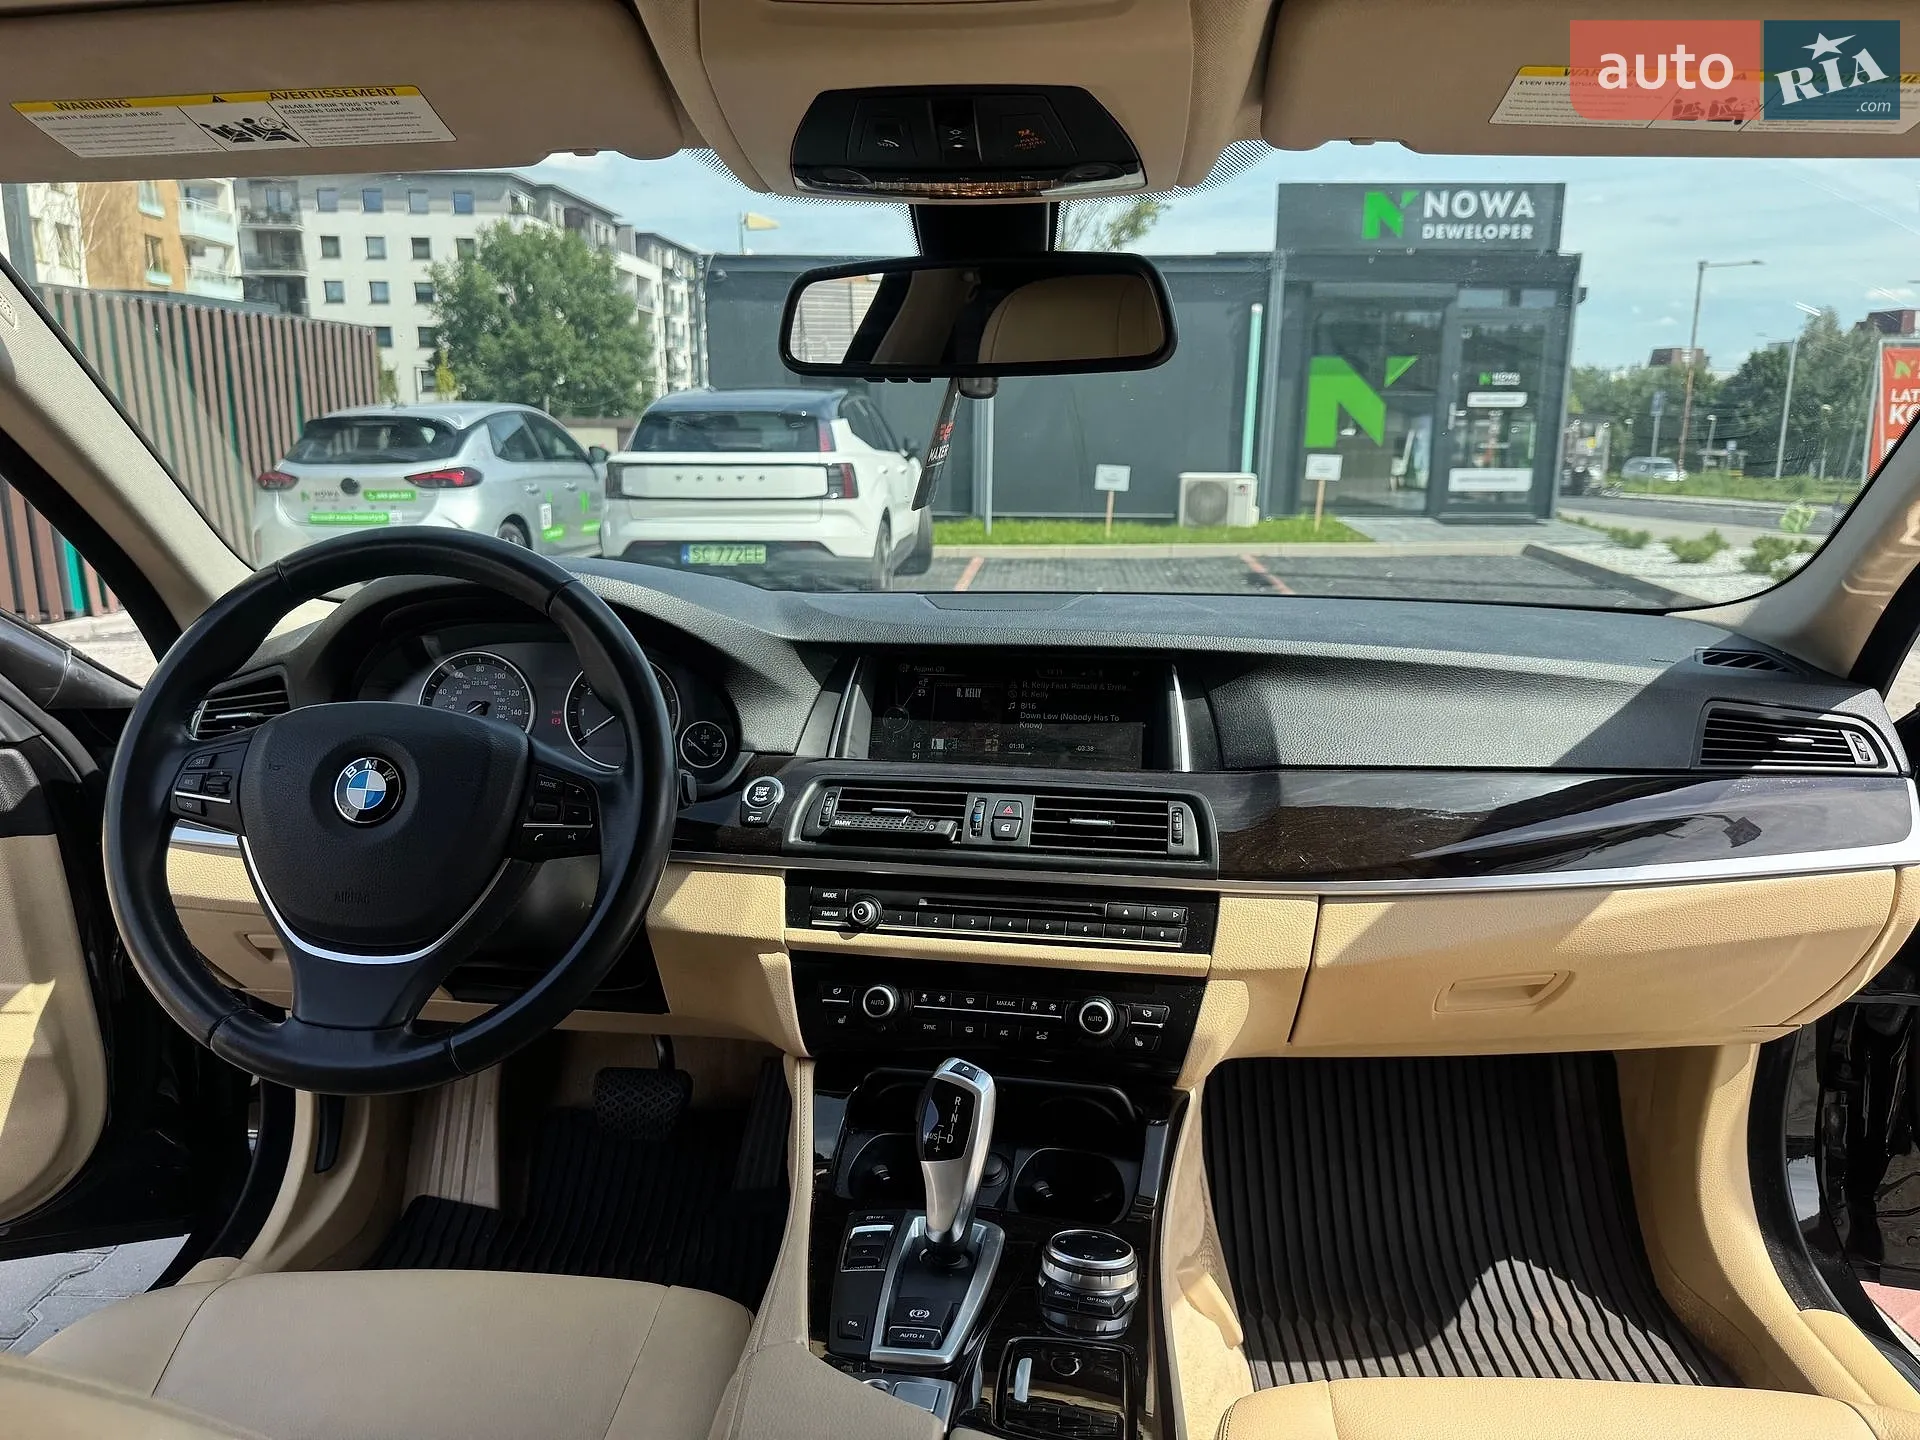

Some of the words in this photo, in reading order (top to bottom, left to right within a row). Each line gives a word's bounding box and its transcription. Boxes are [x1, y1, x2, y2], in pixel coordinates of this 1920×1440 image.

[270, 87, 398, 101] AVERTISSEMENT
[52, 99, 133, 111] WARNING
[1423, 189, 1536, 219] NOWA
[1421, 223, 1534, 240] DEWELOPER
[454, 671, 464, 679] 60
[508, 689, 520, 697] 120
[964, 688, 982, 698] KELLY
[1031, 690, 1049, 700] Kelly
[1020, 702, 1037, 711] 8/16
[510, 708, 522, 716] 140
[1020, 712, 1041, 721] Down
[1042, 713, 1059, 722] Low
[1060, 712, 1090, 723] (Nobody
[1092, 713, 1107, 722] Has
[1108, 714, 1120, 722] To
[1019, 721, 1043, 730] Know)
[345, 759, 396, 782] BMW
[539, 780, 557, 789] MODE
[954, 1096, 962, 1105] R
[950, 1113, 958, 1123] N
[946, 1134, 954, 1144] D
